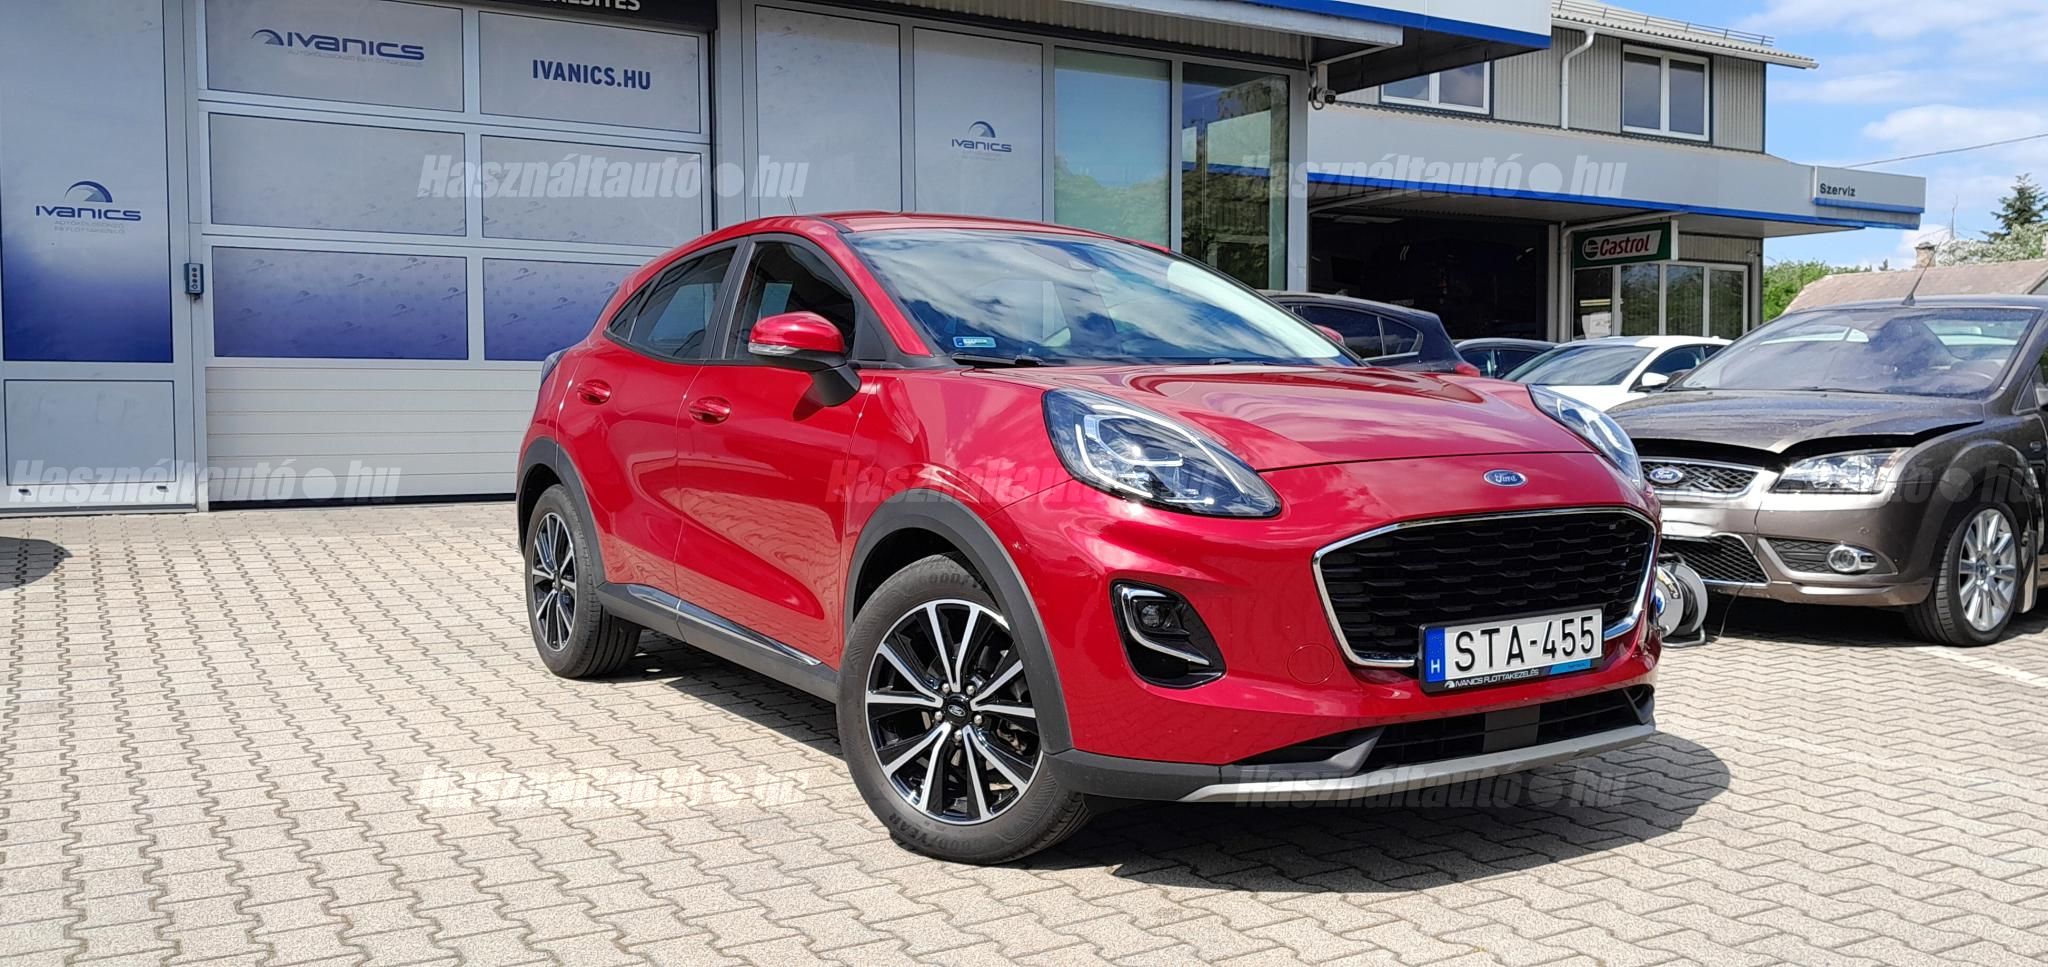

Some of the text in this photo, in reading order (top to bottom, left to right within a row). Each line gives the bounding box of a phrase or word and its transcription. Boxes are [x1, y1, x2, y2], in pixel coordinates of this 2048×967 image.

[533, 60, 650, 90] IVANICS.HU
[1820, 183, 1856, 197] Szerviz
[1600, 234, 1650, 256] Castrol
[1455, 616, 1594, 672] STA-455
[1431, 659, 1441, 673] H
